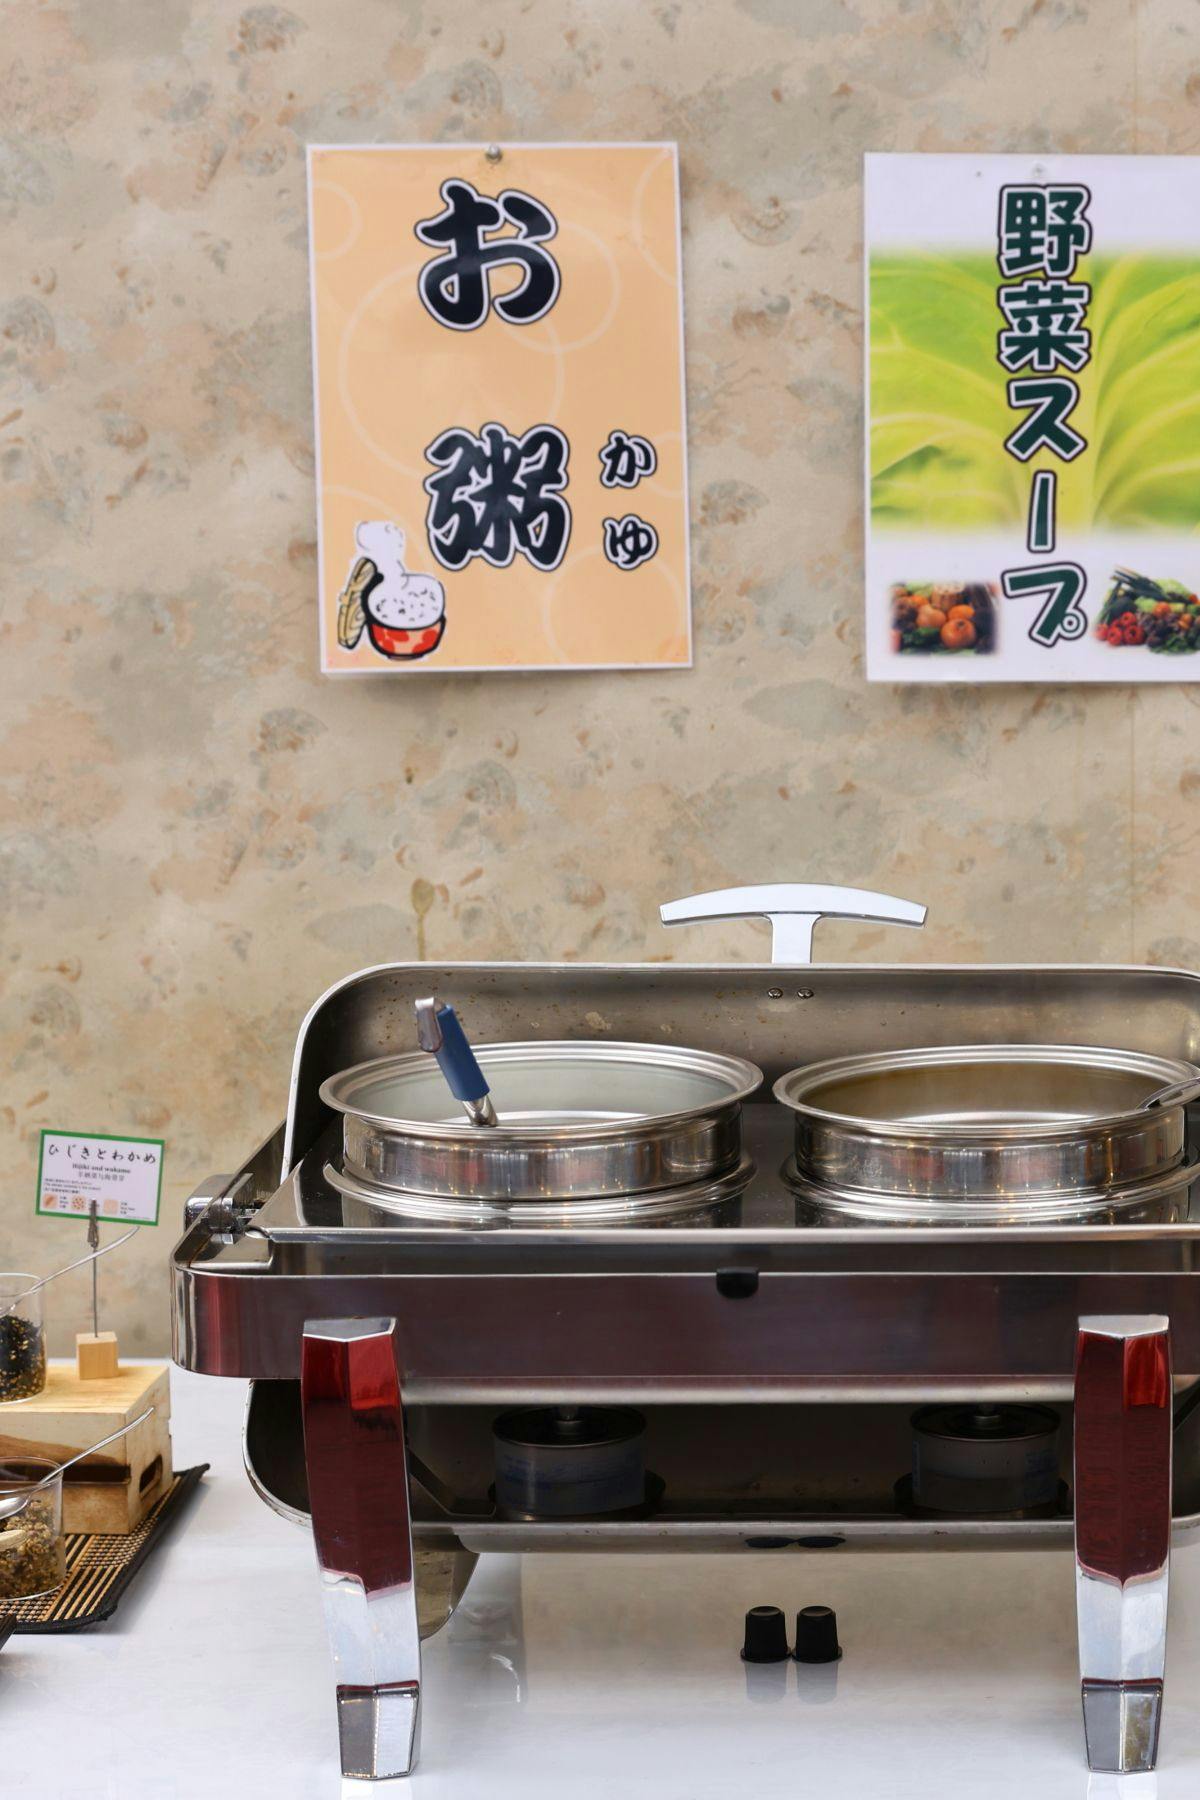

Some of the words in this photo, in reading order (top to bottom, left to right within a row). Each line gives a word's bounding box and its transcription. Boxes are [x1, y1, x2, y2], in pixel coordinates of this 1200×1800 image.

[996, 184, 1092, 647] 野菜スープ
[599, 430, 658, 571] かゆ
[48, 1144, 156, 1164] ひじきとわかめ
